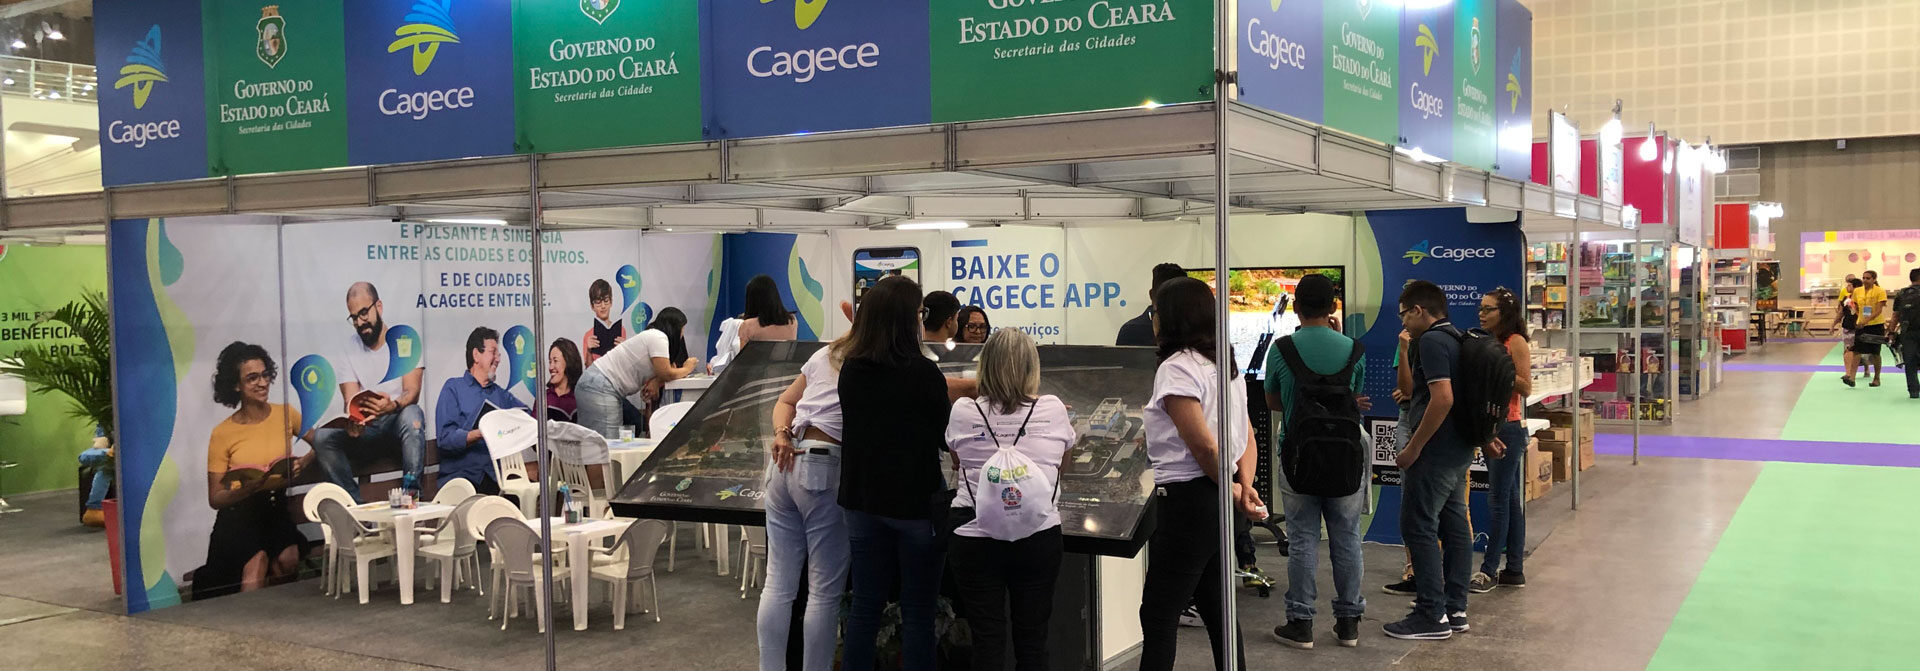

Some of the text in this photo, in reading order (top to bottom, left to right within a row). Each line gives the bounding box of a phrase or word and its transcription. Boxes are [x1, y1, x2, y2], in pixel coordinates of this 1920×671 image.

[958, 16, 1049, 44] ESTADO
[1054, 16, 1082, 34] DO
[1341, 22, 1385, 61] GOVERNO DO
[549, 36, 656, 61] GOVERNO DO
[993, 33, 1137, 60] Secretaria das Cidades
[1248, 17, 1306, 70] Cagece
[530, 51, 679, 90] ESTADO DO CEARÁ
[747, 42, 880, 83] Cagece
[1332, 45, 1392, 89] ESTADO DO CEARÁ
[234, 79, 313, 99] GOVERNO DO
[554, 83, 653, 103] Secretaria das Cidades
[1411, 81, 1443, 119] Cagece
[220, 93, 330, 123] ESTADO DO CEARÁ
[378, 85, 475, 120] Cagece
[108, 119, 180, 148] Cagece
[238, 119, 312, 135] Secretaria das Cidades
[491, 227, 499, 241] A
[503, 228, 563, 244] SINEGIA
[367, 245, 419, 260] ENTRE
[424, 246, 441, 261] AS
[445, 246, 504, 262] CIDADES
[508, 249, 515, 262] E
[541, 249, 589, 265] IVROS.
[951, 252, 1060, 280] BAIXE O
[1430, 246, 1496, 261] Cagece
[440, 273, 531, 287] E DE CIDADES
[416, 293, 551, 308] A CAGECE ENTENE.
[952, 282, 1127, 310] CAGECE APP.
[1, 313, 8, 321] 3
[11, 312, 31, 321] MIL
[1019, 322, 1060, 339] rviços
[1381, 475, 1401, 484] Goog
[1470, 481, 1490, 489] Store
[739, 488, 767, 500] Cag
